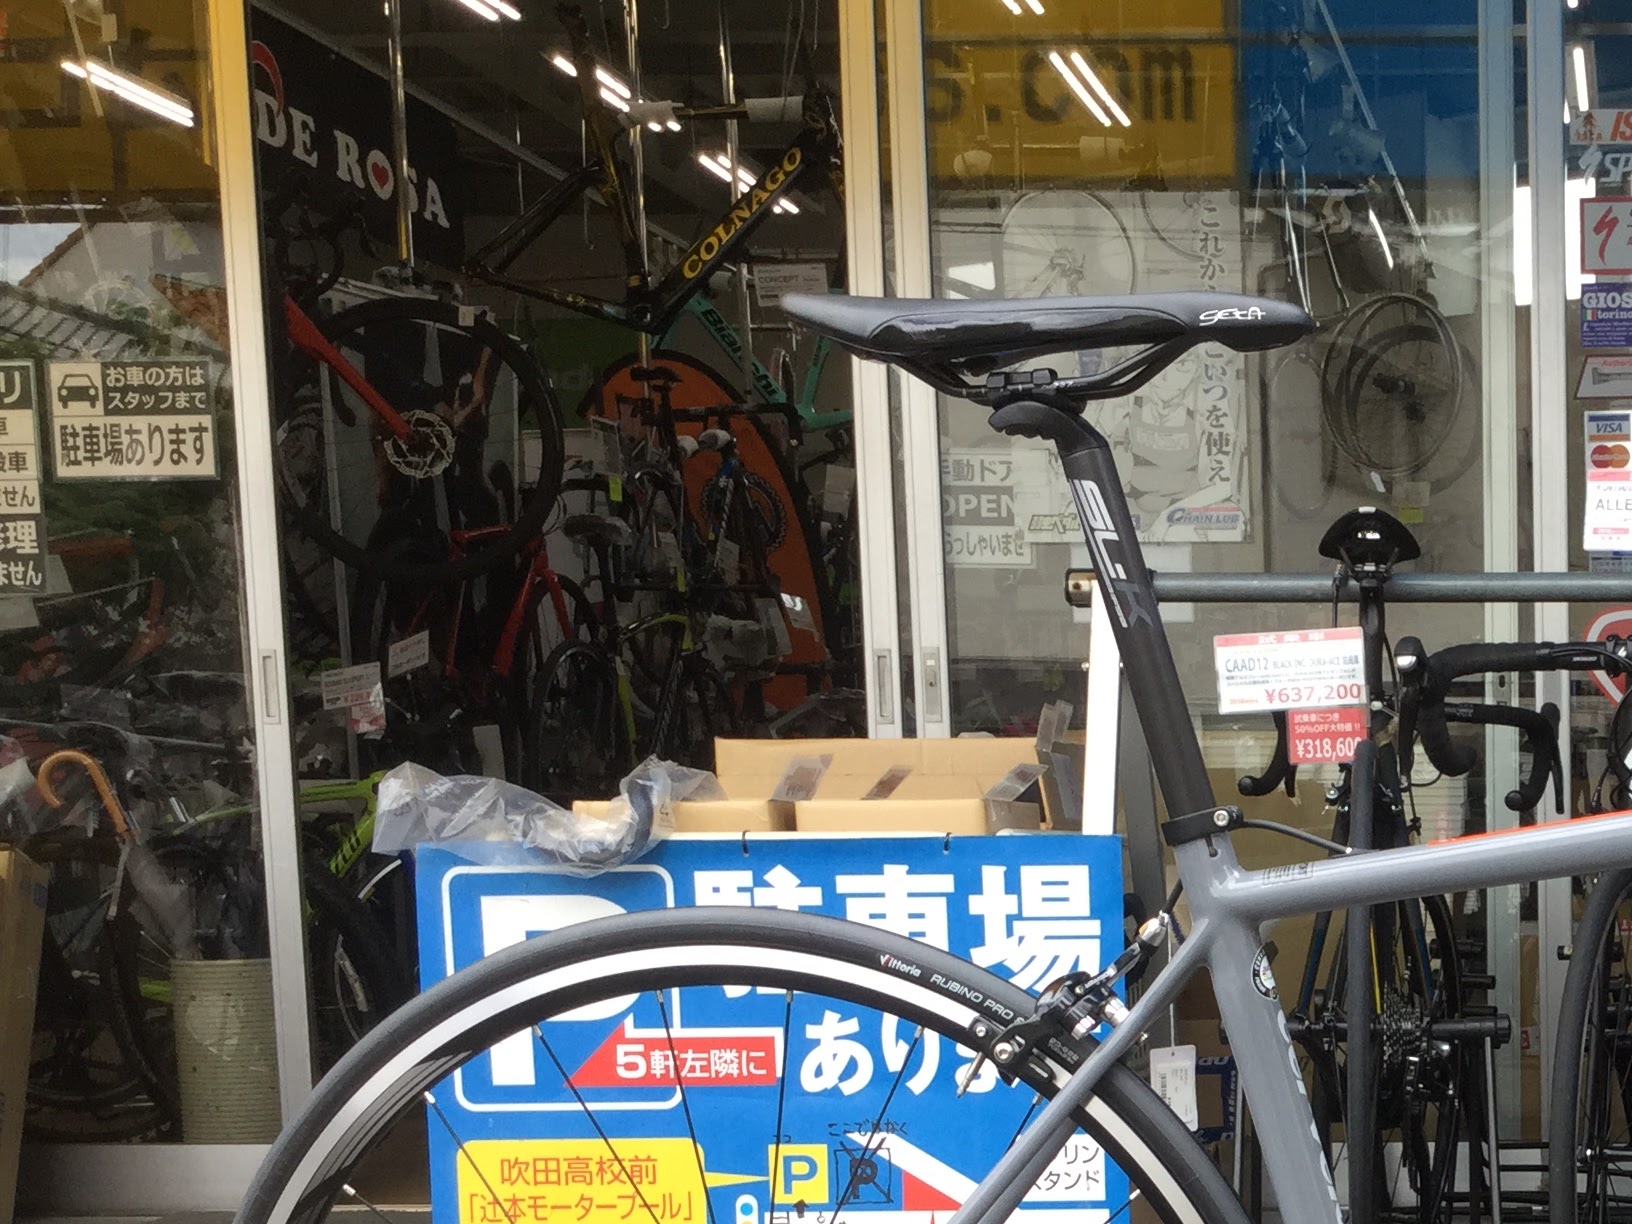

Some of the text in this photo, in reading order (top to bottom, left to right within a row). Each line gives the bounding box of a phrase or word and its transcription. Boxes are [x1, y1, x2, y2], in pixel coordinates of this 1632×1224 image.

[257, 90, 450, 229] DE ROSA
[683, 147, 801, 280] COLNAGO
[106, 365, 204, 388] お車の方は
[107, 391, 206, 410] スタッフまで
[60, 421, 209, 467] 駐車場あります
[1595, 423, 1623, 433] VISA
[1225, 657, 1269, 673] CAAD12
[1264, 683, 1361, 705] ¥637,200
[879, 953, 1015, 1019] Vittoria RUBINO PRO
[616, 1045, 766, 1080] 5軒左隣に
[500, 1155, 658, 1187] 吹田高校前
[783, 1155, 818, 1195] P
